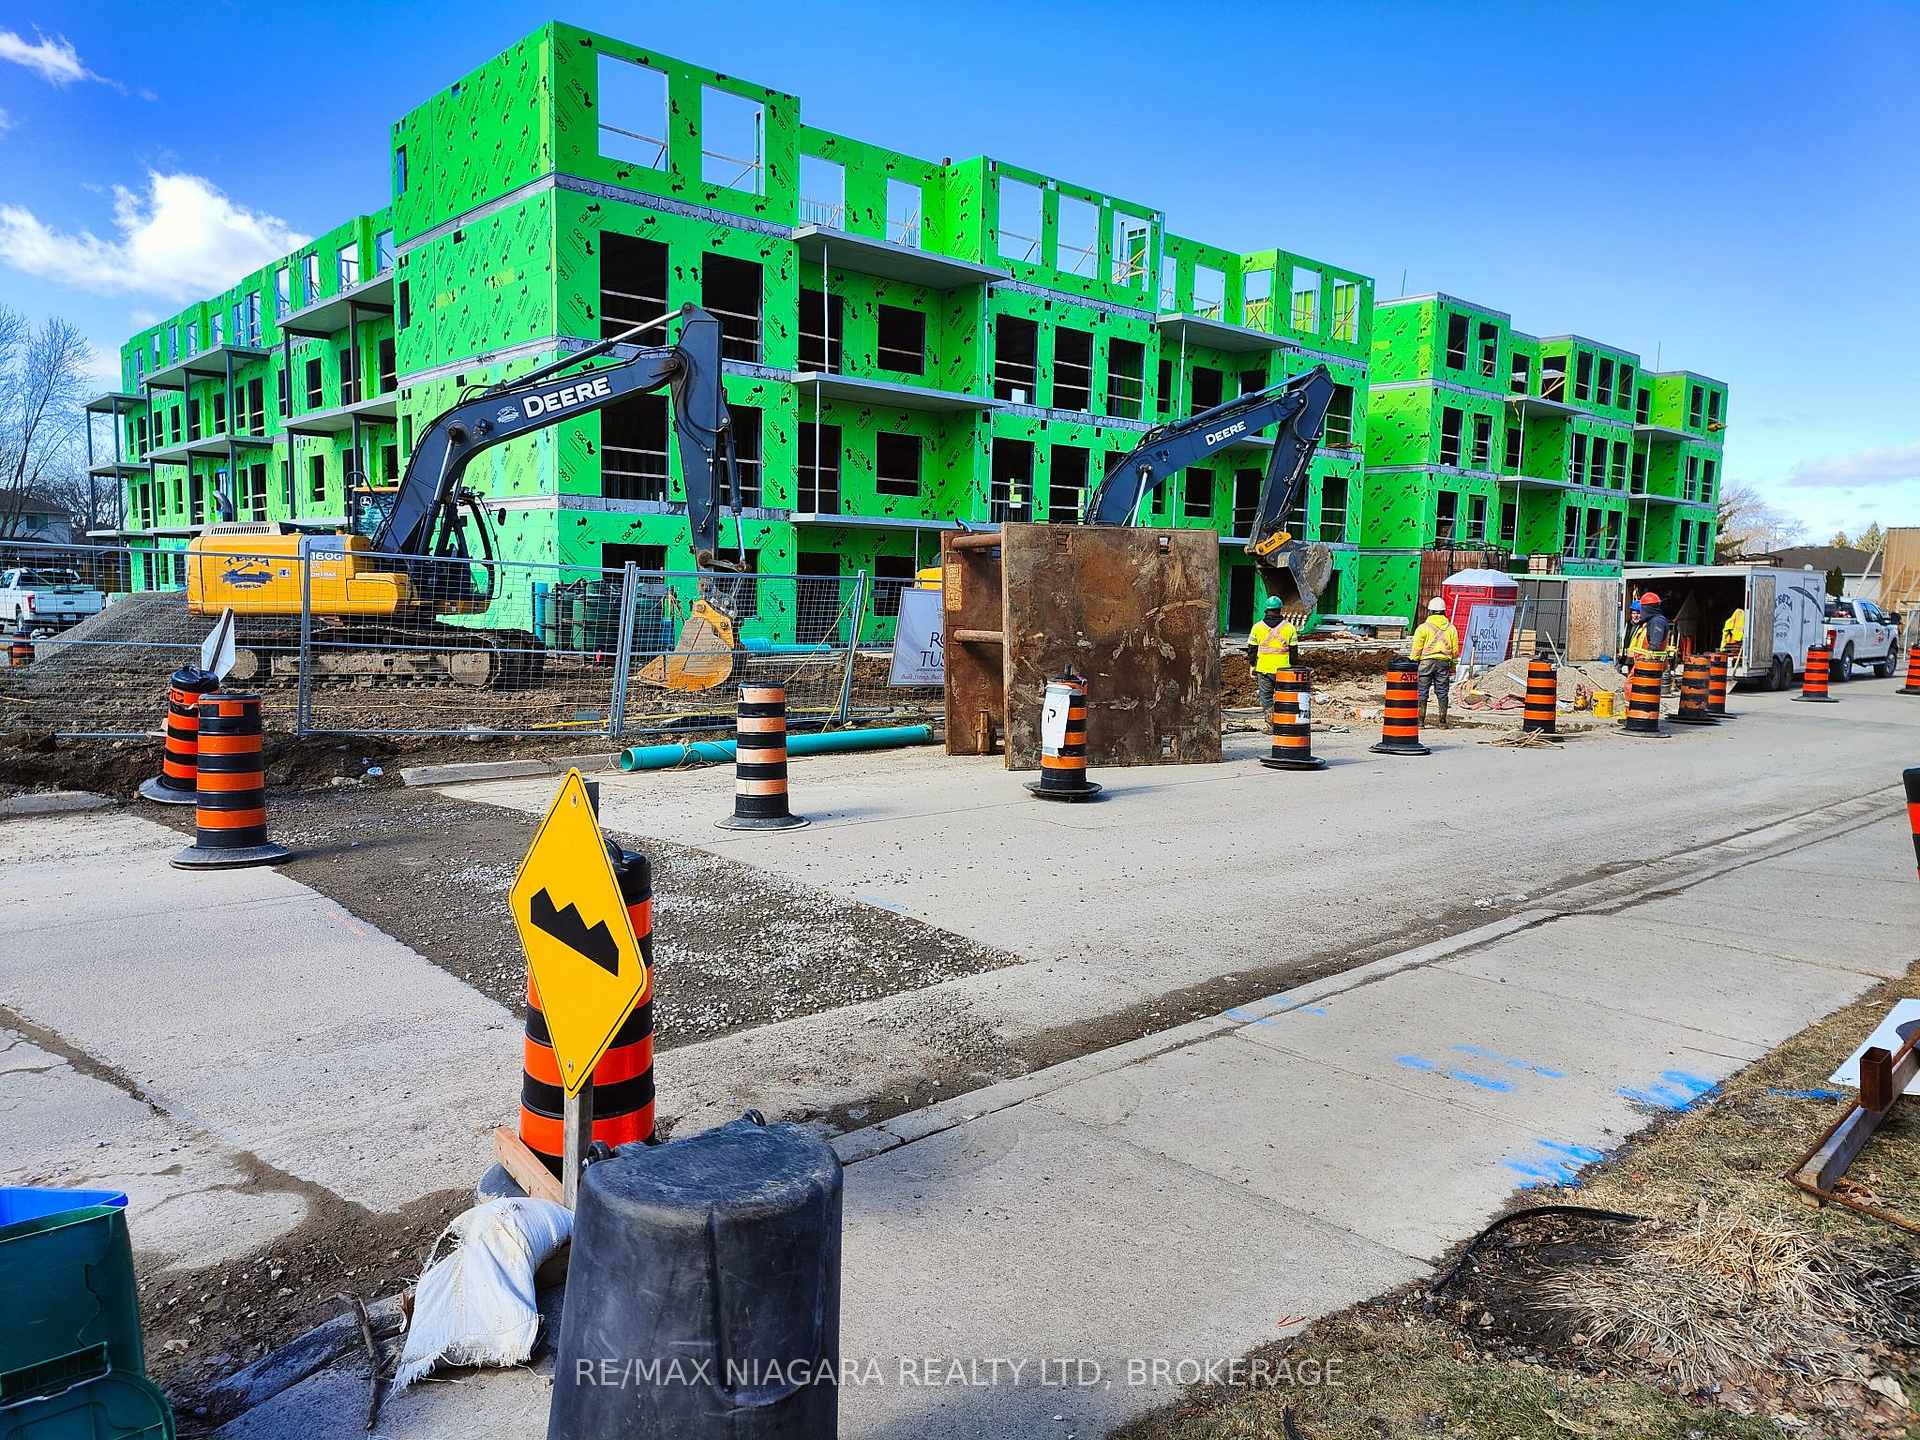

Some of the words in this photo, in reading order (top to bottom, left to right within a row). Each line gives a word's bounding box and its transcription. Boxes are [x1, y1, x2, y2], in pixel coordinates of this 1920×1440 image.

[578, 210, 592, 224] CGC
[573, 228, 586, 242] CGC
[574, 293, 587, 308] CGC
[770, 314, 781, 328] CGC
[523, 376, 611, 418] DEERE
[745, 393, 756, 404] CGC
[770, 421, 781, 434] CGC
[1205, 421, 1247, 446] DEERE
[574, 430, 587, 444] CGC
[770, 478, 781, 491] CGC
[622, 528, 635, 542] CGC
[311, 551, 343, 561] 160G
